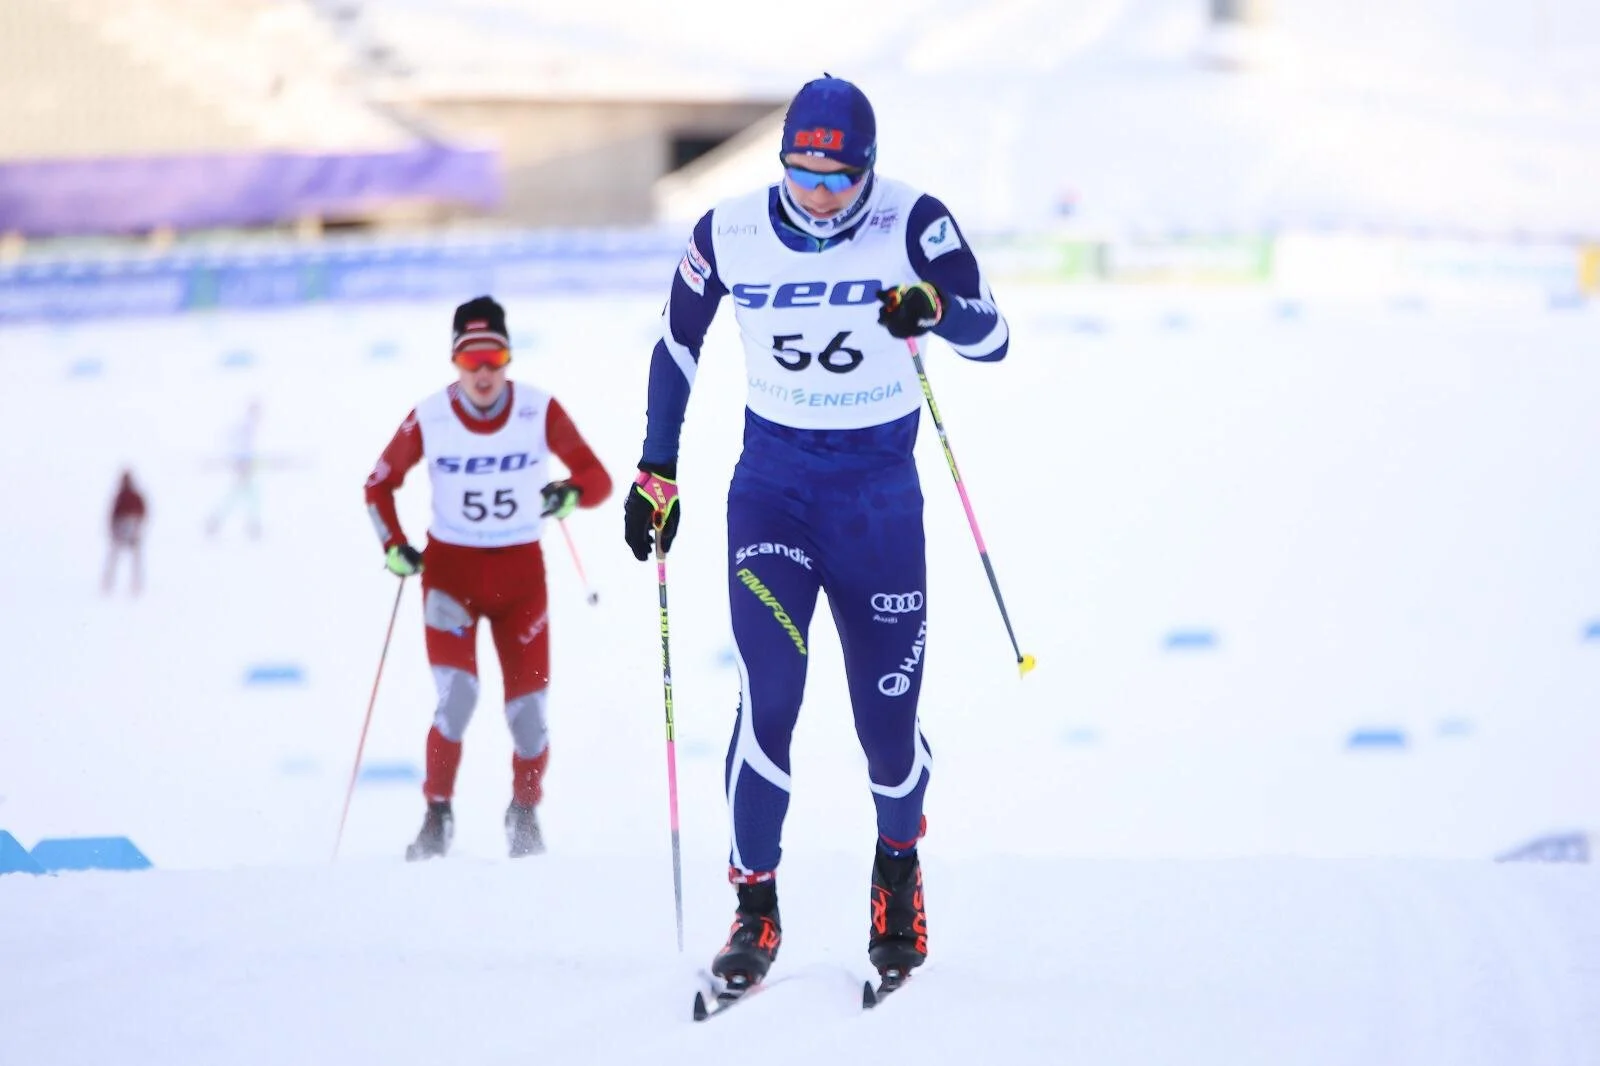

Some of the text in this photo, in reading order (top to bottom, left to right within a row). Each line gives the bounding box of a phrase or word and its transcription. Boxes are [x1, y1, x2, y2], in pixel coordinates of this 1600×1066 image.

[773, 331, 865, 374] 56
[808, 380, 904, 407] ENERGIA
[462, 488, 519, 522] 55
